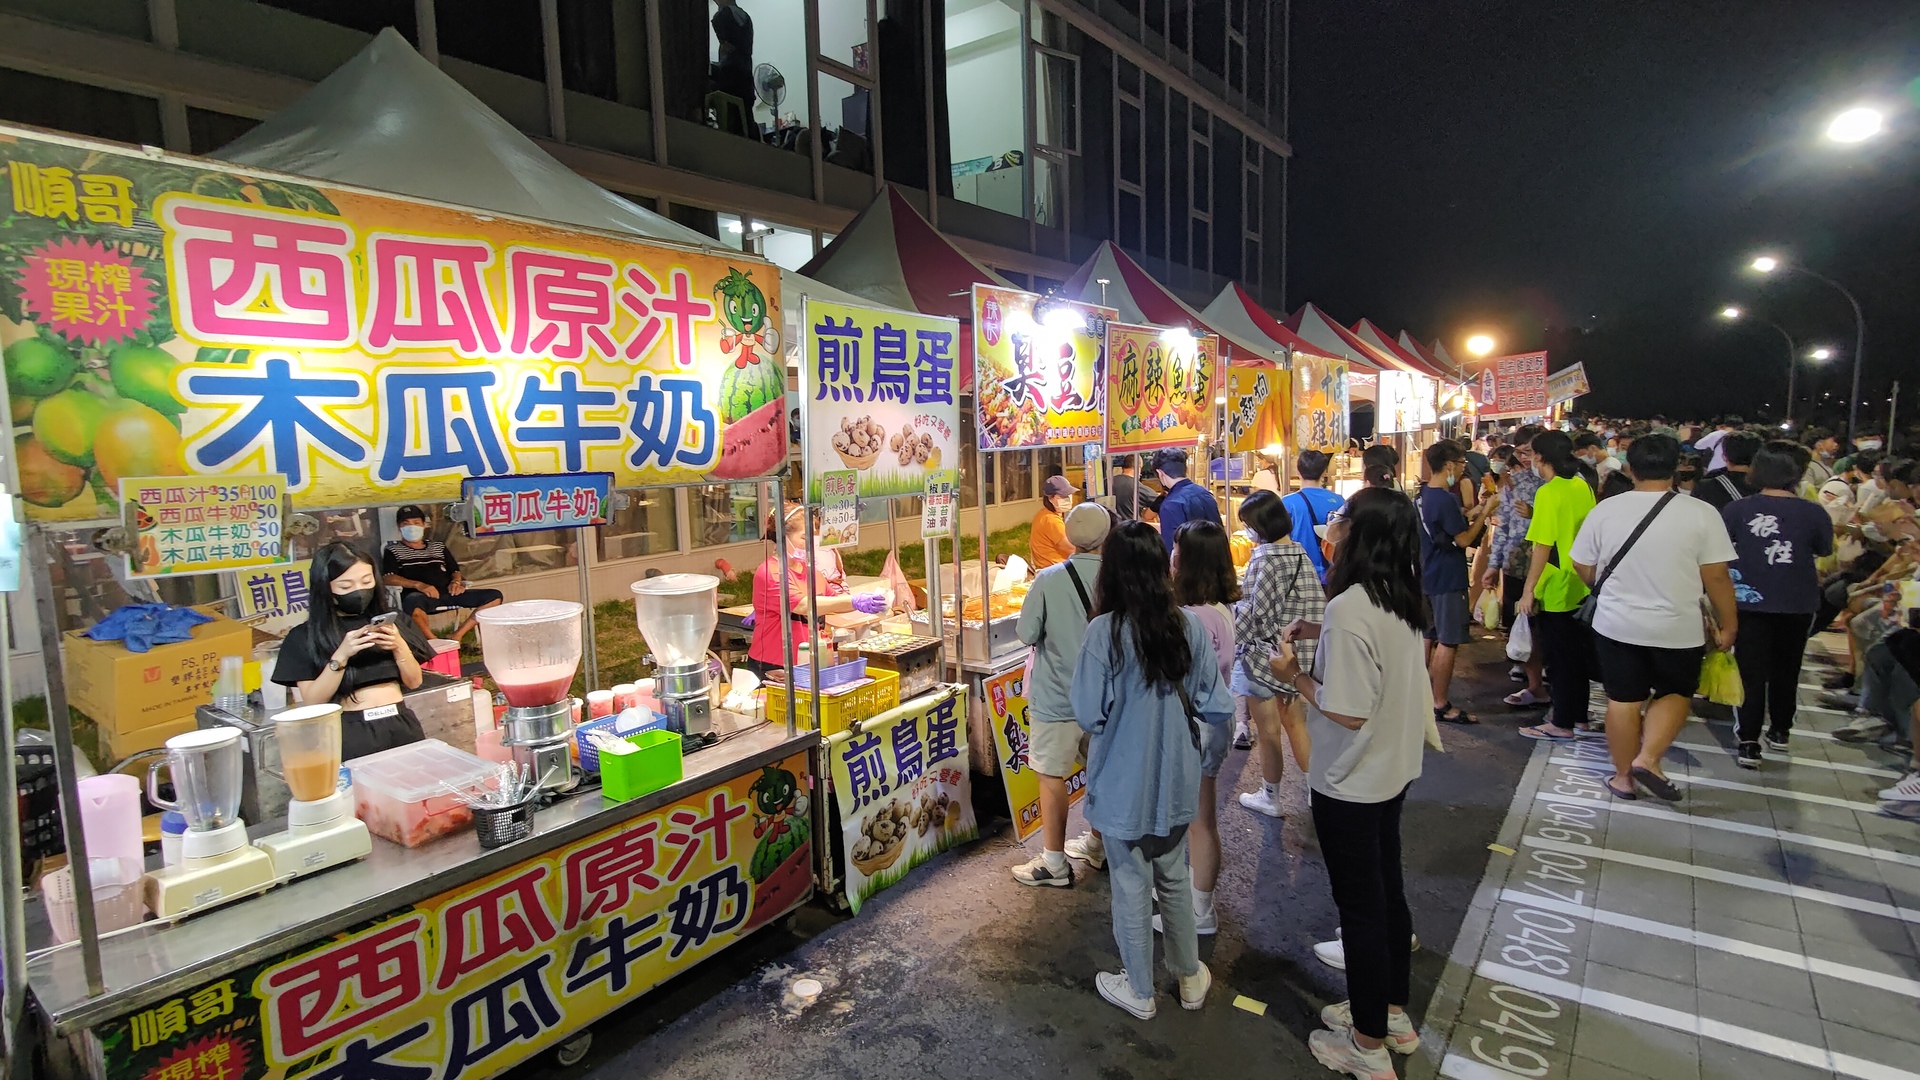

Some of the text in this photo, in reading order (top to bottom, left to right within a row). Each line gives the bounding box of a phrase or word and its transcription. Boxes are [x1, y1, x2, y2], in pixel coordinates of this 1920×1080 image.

[11, 161, 135, 228] 順哥
[47, 257, 132, 295] 現榨
[174, 206, 713, 365] 西瓜原汁
[51, 292, 134, 328] 果汁
[815, 315, 953, 405] 煎鳥蛋
[1120, 343, 1209, 406] 麻辣魚蛋
[189, 358, 717, 486] 木瓜牛奶
[914, 414, 951, 441] 好吃又營養
[140, 487, 209, 504] 西瓜汁
[218, 486, 240, 501] 35
[251, 485, 276, 500] 100
[825, 474, 856, 497] 煎鳥蛋
[160, 504, 249, 524] 西瓜牛奶
[257, 504, 277, 519] 50
[482, 488, 599, 525] 西瓜牛奶
[927, 516, 948, 529] 油膏
[160, 523, 250, 544] 木瓜牛奶
[258, 522, 279, 537] 50
[162, 543, 251, 563] 木瓜牛奶
[259, 541, 280, 556] 60
[142, 703, 161, 713] MADE
[173, 694, 198, 704] TAIWAN
[842, 697, 959, 815] 煎鳥蛋
[911, 768, 962, 800] 好吃又營養
[1553, 766, 1605, 799] 045
[1537, 803, 1597, 845] 046
[1523, 849, 1588, 906] 047
[270, 795, 747, 1053] 西瓜原汁
[1500, 907, 1575, 976] 048
[303, 866, 749, 1080] 木瓜牛奶
[129, 979, 238, 1051] 順哥
[1470, 984, 1561, 1077] 049
[157, 1042, 231, 1080] 現榨
